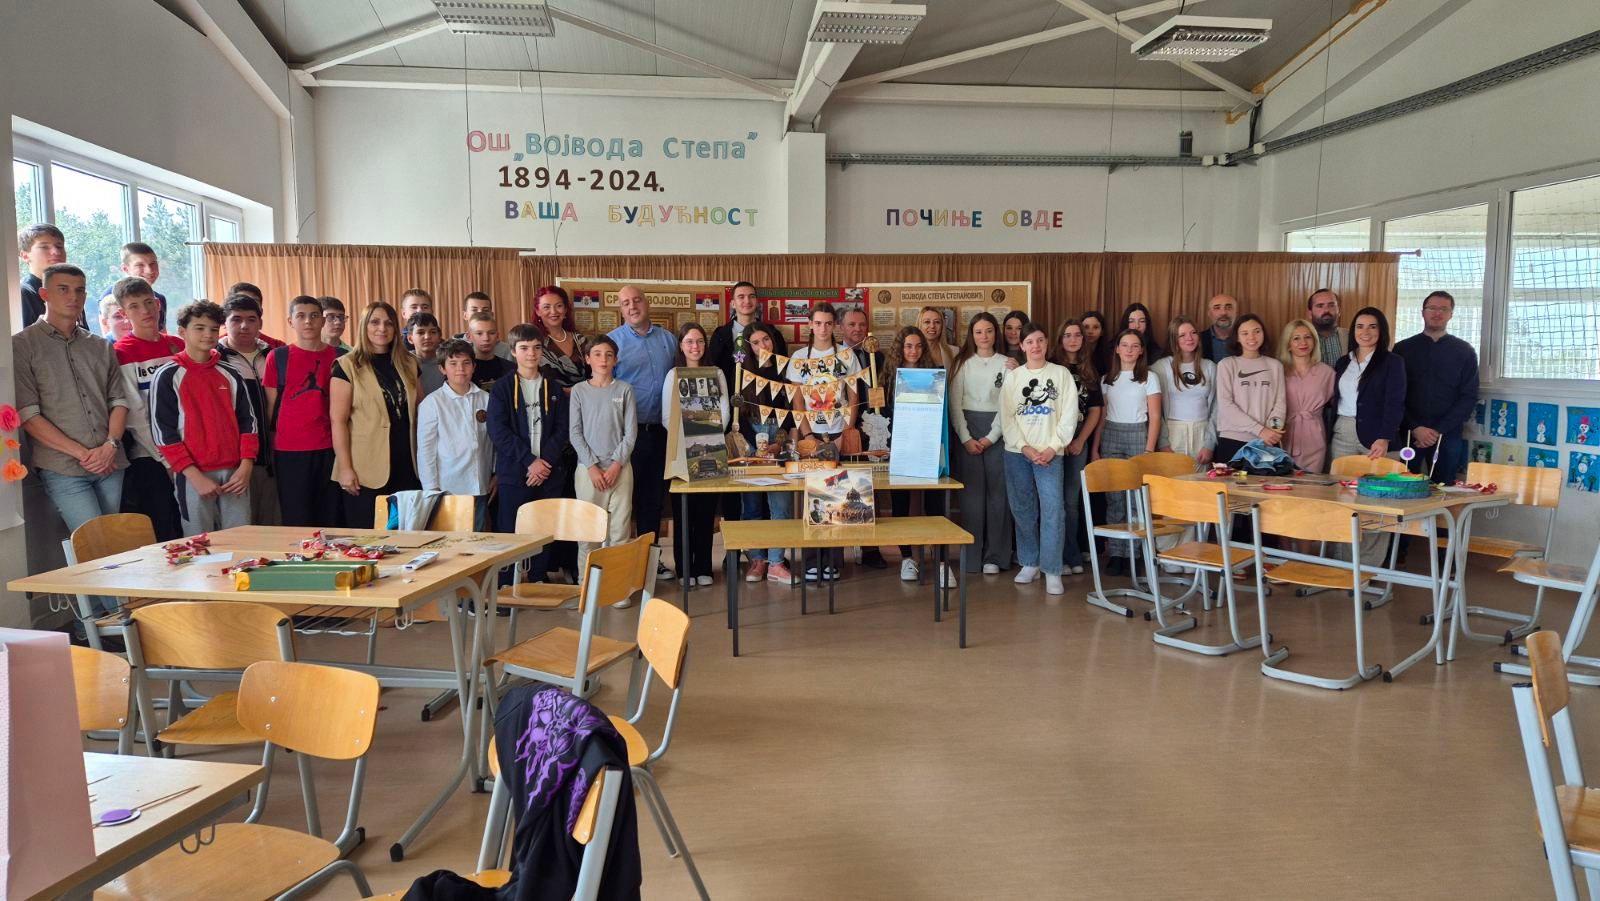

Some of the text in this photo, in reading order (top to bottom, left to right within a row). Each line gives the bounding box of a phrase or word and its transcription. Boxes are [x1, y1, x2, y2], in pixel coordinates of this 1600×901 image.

[467, 130, 511, 153] ОШ
[498, 165, 666, 192] 1894-2024.
[504, 200, 758, 227] ВАША БУДУЋНОСТ
[886, 208, 1064, 231] ПОЧИЊЕ ОВДЕ
[901, 291, 927, 301] ВОЈВОДА
[927, 291, 946, 300] СТЕПА
